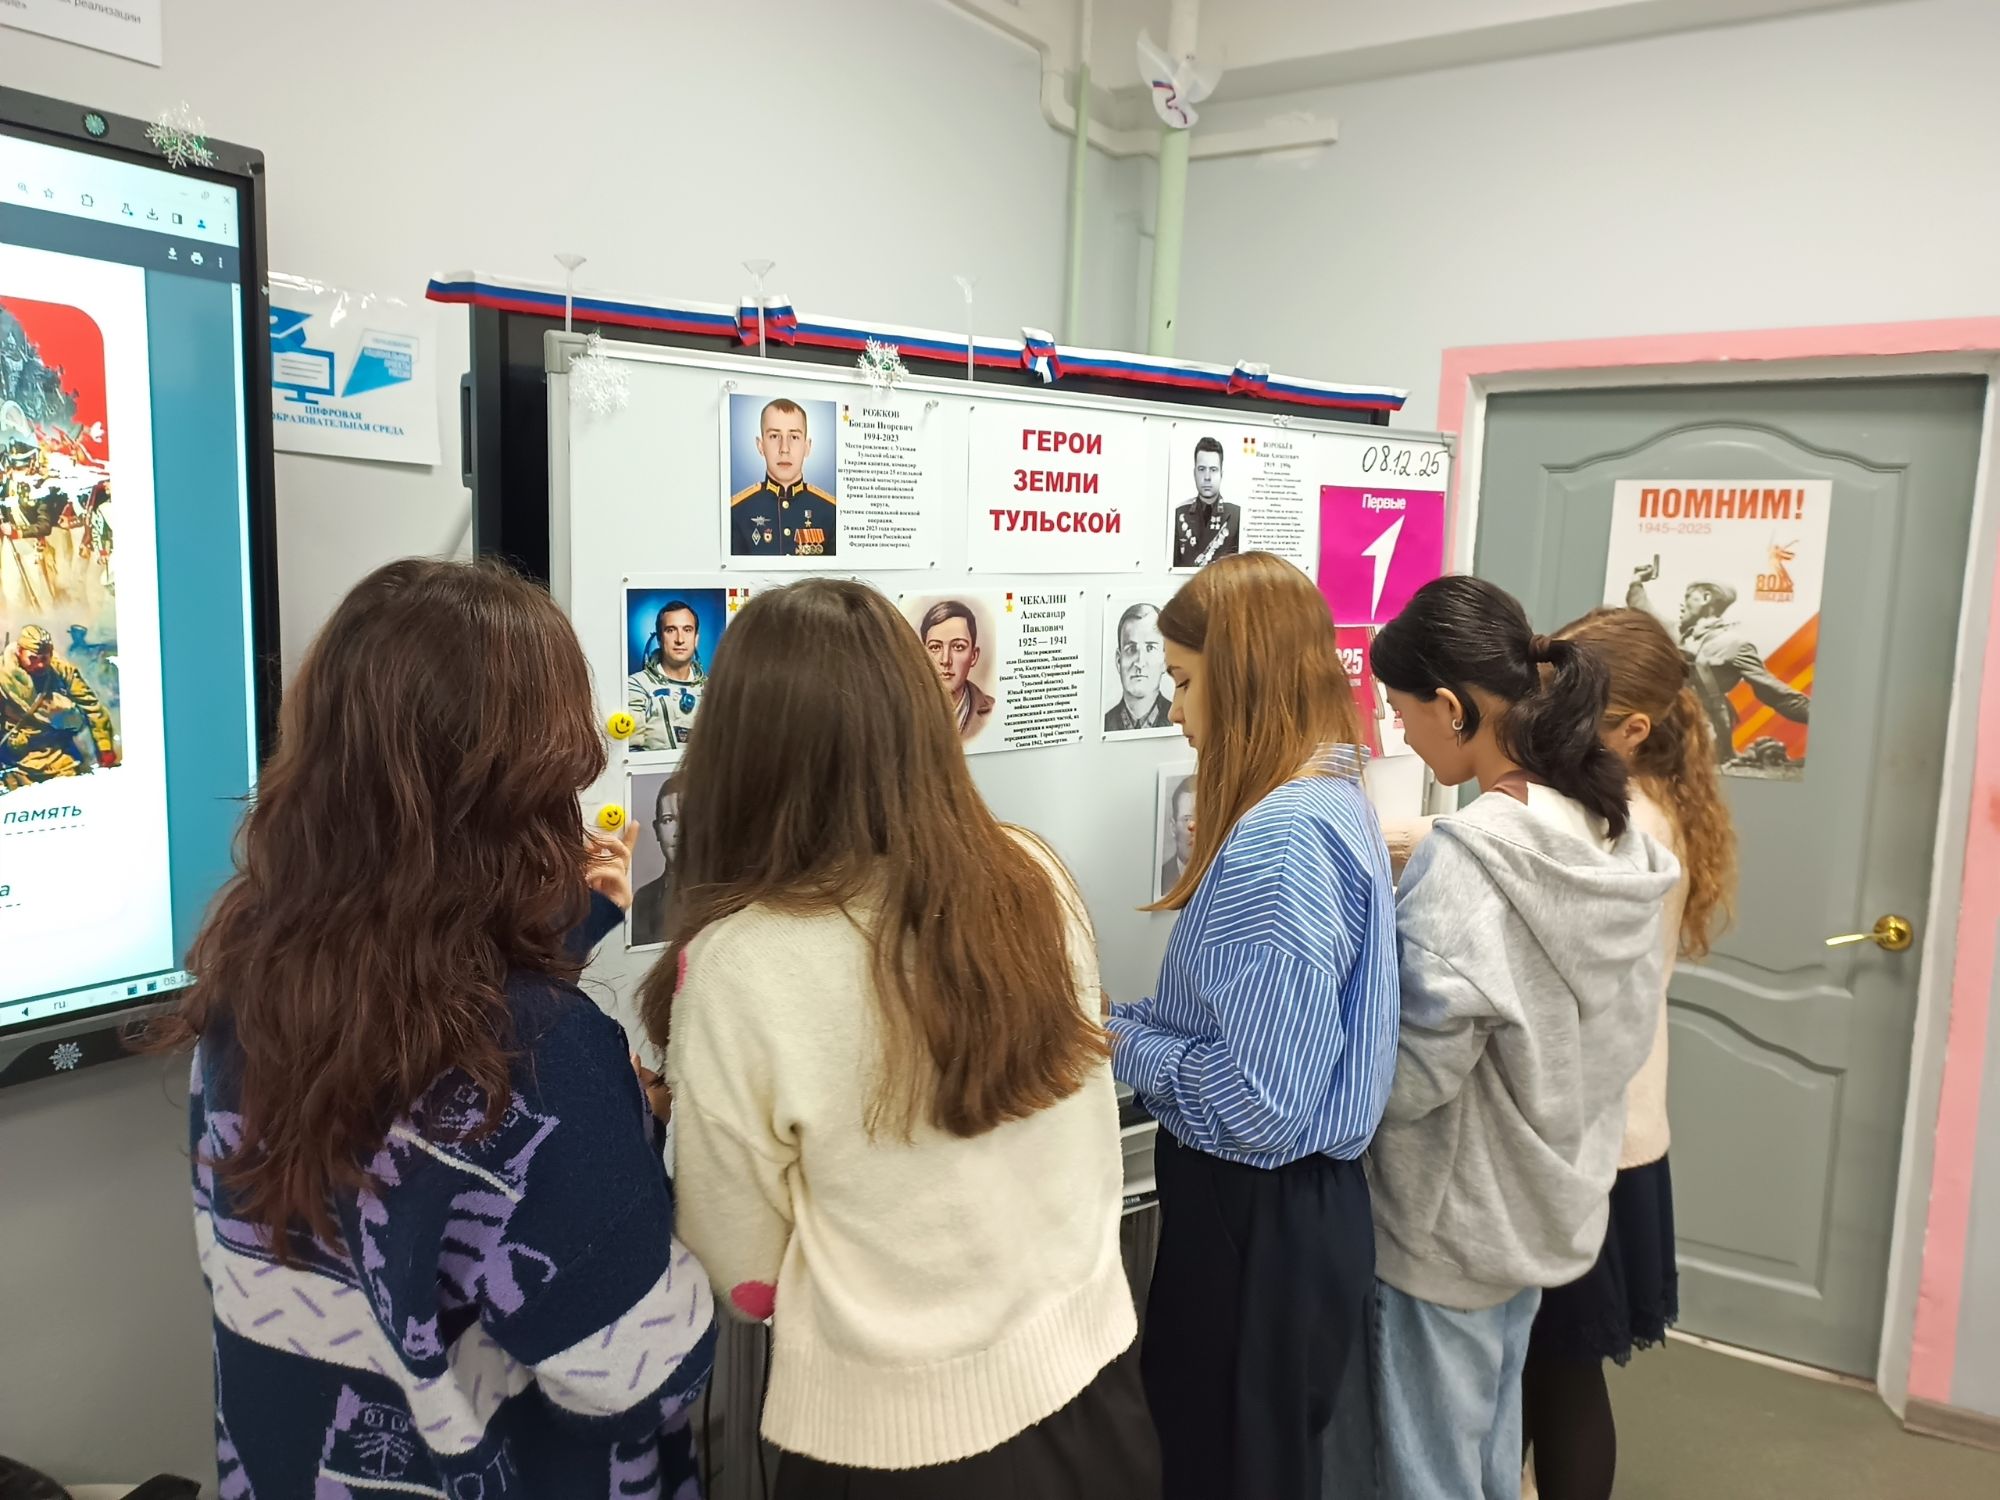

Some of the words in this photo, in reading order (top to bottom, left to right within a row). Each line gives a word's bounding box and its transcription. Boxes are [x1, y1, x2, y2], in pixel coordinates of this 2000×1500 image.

[305, 405, 362, 420] ЦИФРОВАЯ
[863, 408, 900, 418] РОЖКОВ
[372, 423, 404, 435] СРЕДА
[850, 419, 875, 429] Богдан
[877, 421, 913, 431] Игоревич
[1022, 429, 1102, 455] ГЕРОИ
[1013, 469, 1098, 494] ЗЕМЛИ
[1362, 493, 1406, 513] Первые
[1639, 488, 1805, 520] ПОМНИМ!
[989, 508, 1121, 533] ТУЛЬСКОЙ
[1020, 594, 1067, 605] ЧЕКАЛИН
[1020, 610, 1066, 620] Александр
[1023, 624, 1064, 633] Павлович
[1050, 635, 1067, 645] 1941
[3, 805, 83, 824] память
[53, 1000, 66, 1010] ru
